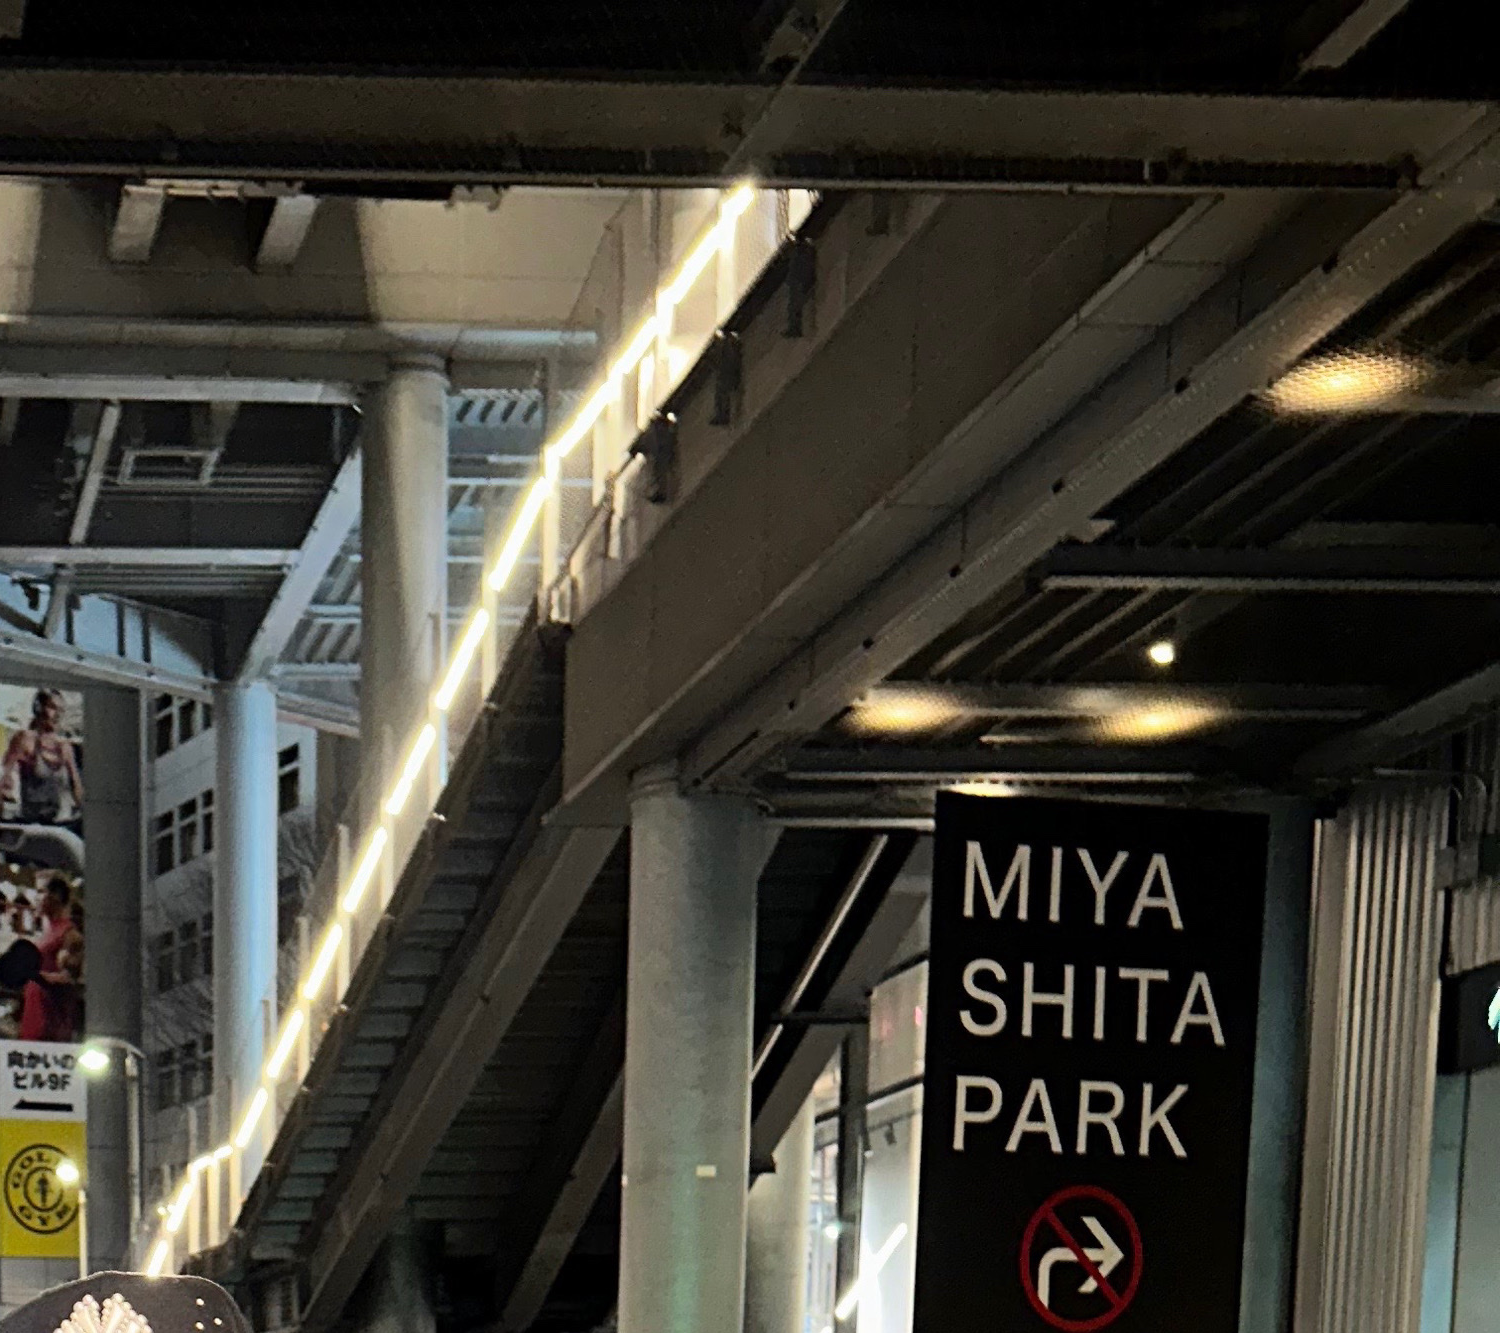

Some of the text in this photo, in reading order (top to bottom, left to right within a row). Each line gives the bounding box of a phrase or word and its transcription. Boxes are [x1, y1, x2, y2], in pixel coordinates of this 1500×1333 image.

[962, 840, 1184, 931] MIYA
[959, 958, 1226, 1047] SHITA
[952, 1074, 1189, 1159] PARK
